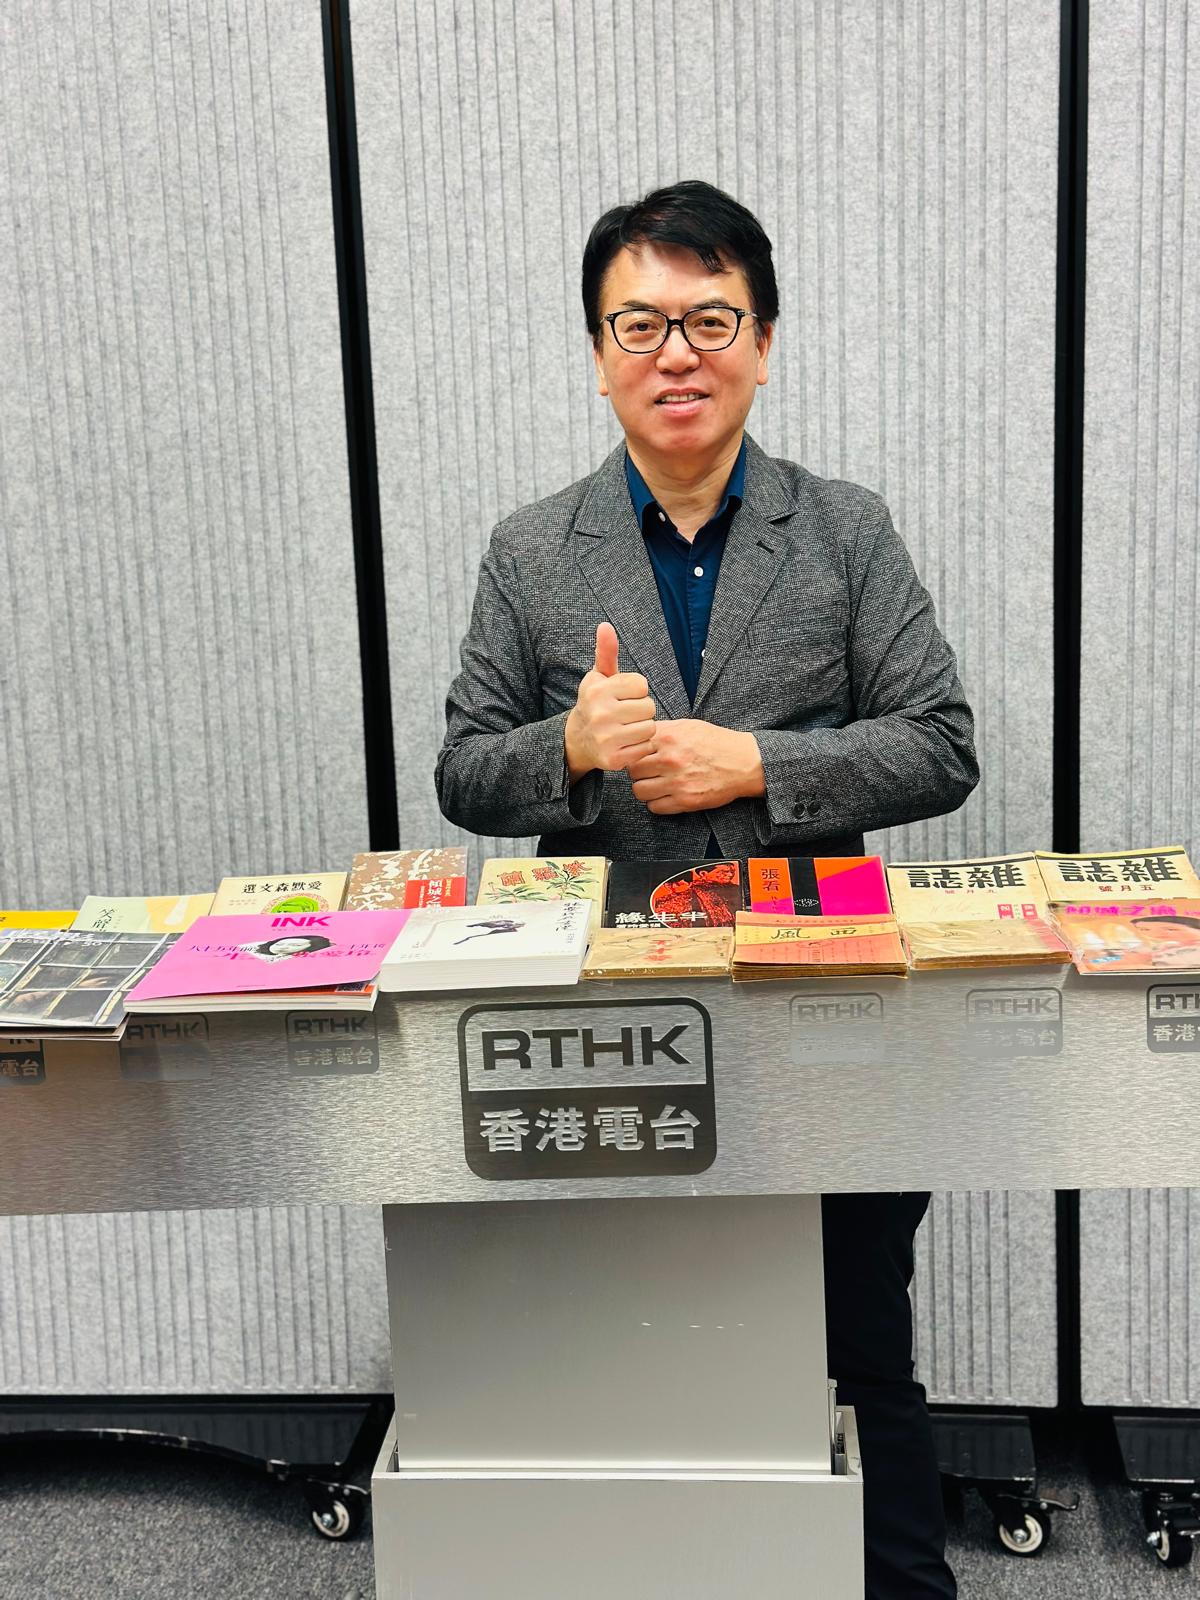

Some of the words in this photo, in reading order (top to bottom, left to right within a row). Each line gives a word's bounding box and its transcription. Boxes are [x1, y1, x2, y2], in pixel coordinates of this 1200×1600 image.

[761, 868, 781, 891] 張看
[271, 916, 332, 927] INK
[798, 1002, 875, 1020] RTHK
[975, 997, 1055, 1016] RTHK
[294, 1017, 367, 1034] RTHK
[1153, 1024, 1200, 1042] 香港
[294, 1046, 374, 1066] 香港電台
[481, 1025, 692, 1071] RTHK
[479, 1105, 701, 1153] 香港電台
